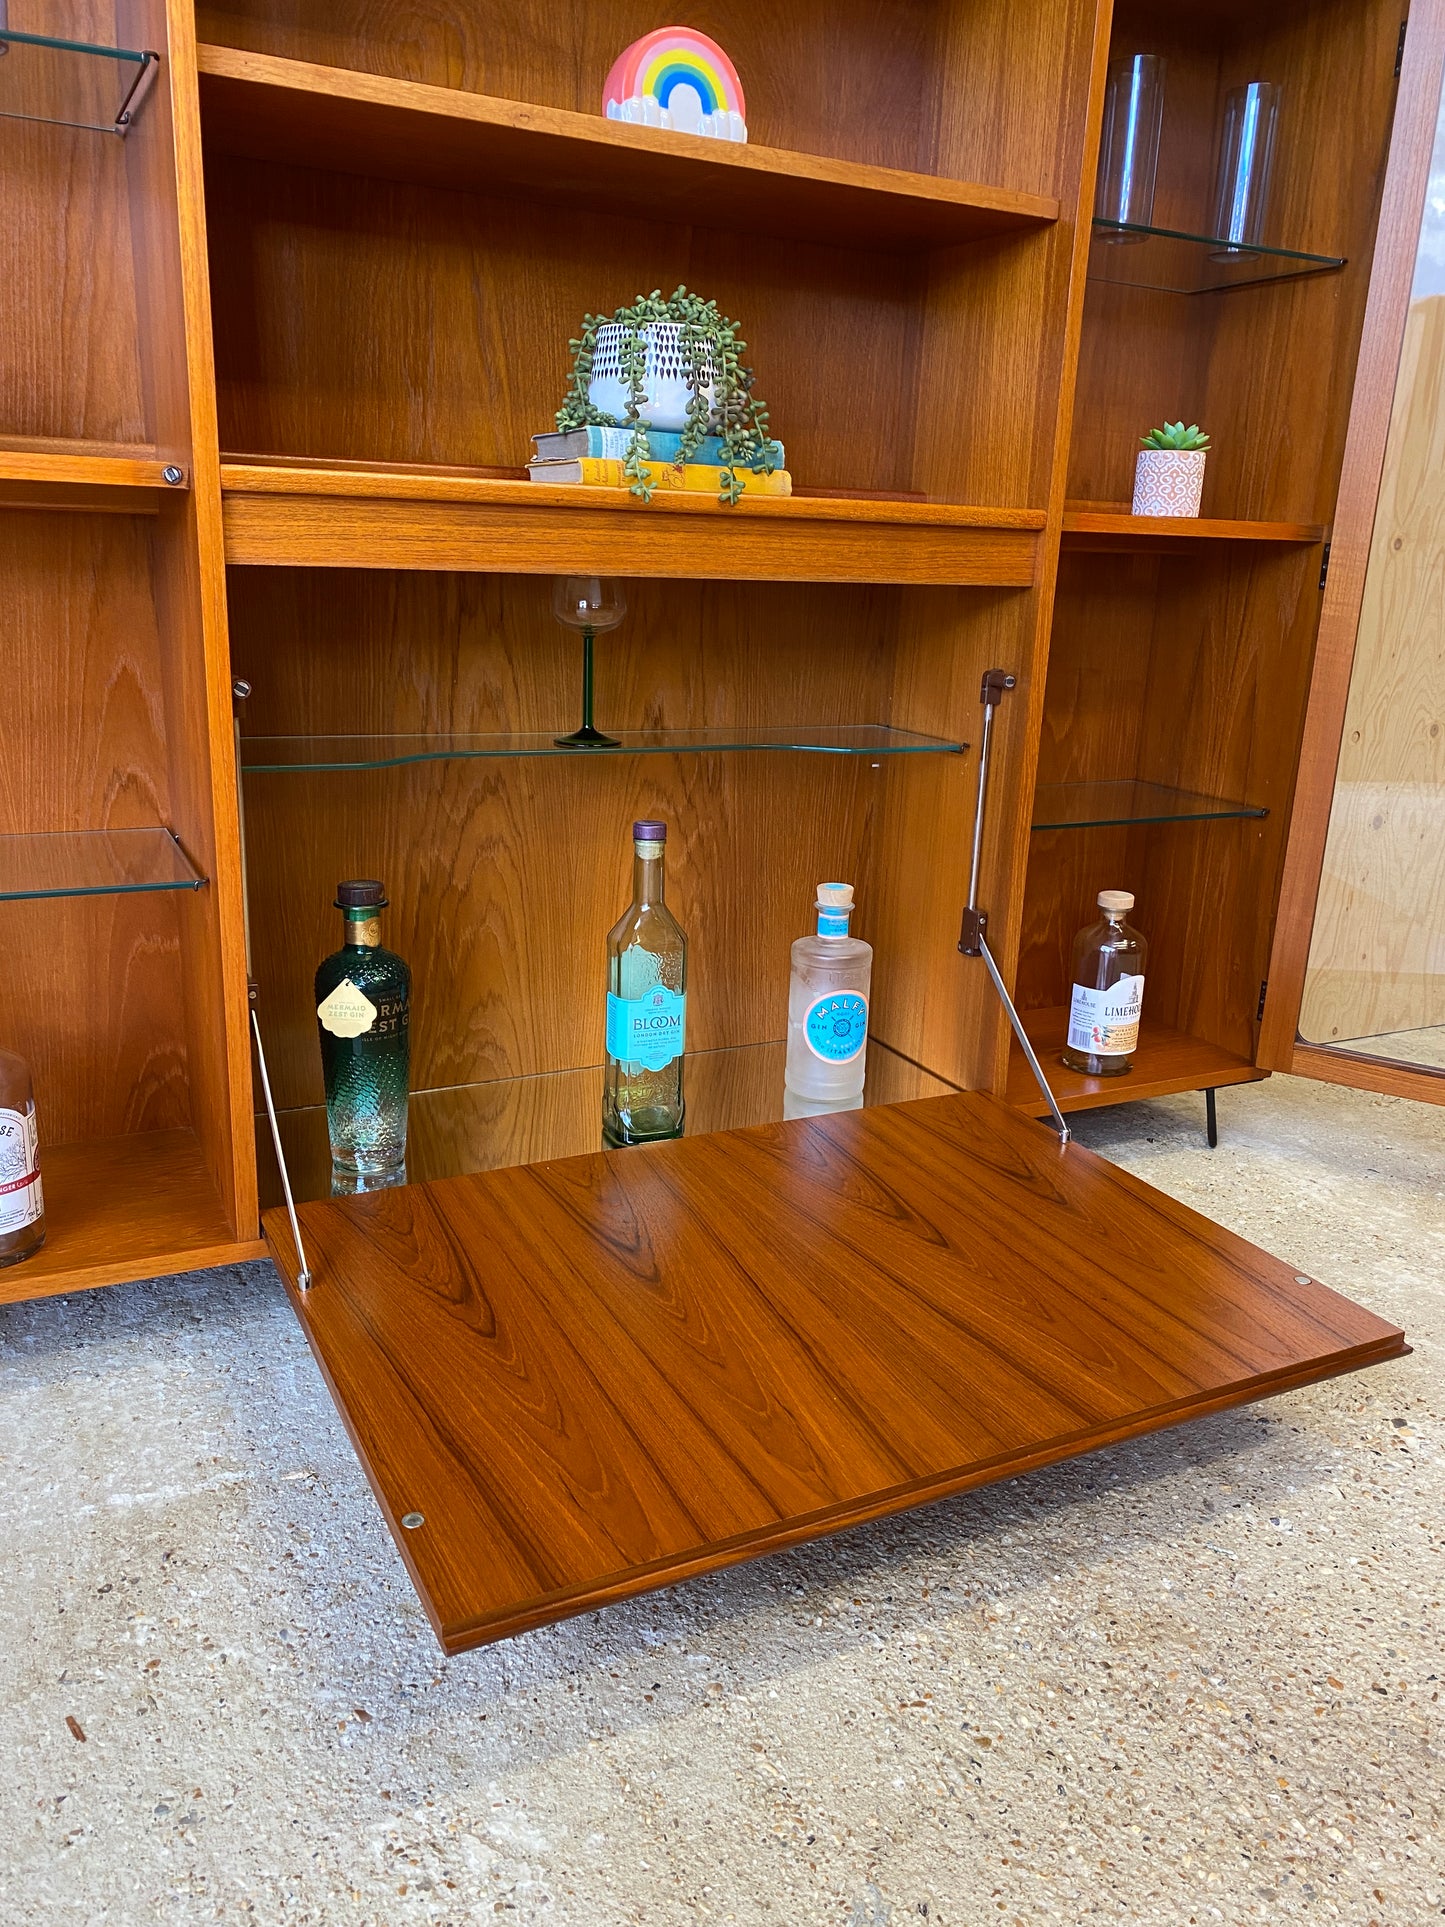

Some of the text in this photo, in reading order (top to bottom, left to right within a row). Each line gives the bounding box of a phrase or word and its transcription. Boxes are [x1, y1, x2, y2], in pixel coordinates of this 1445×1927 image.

[327, 1004, 366, 1012] MERMAID
[815, 998, 865, 1019] MALFY
[368, 1018, 397, 1034] EST
[633, 1015, 681, 1030] BLOOM
[0, 1125, 15, 1137] SE
[0, 1184, 16, 1193] NGER
